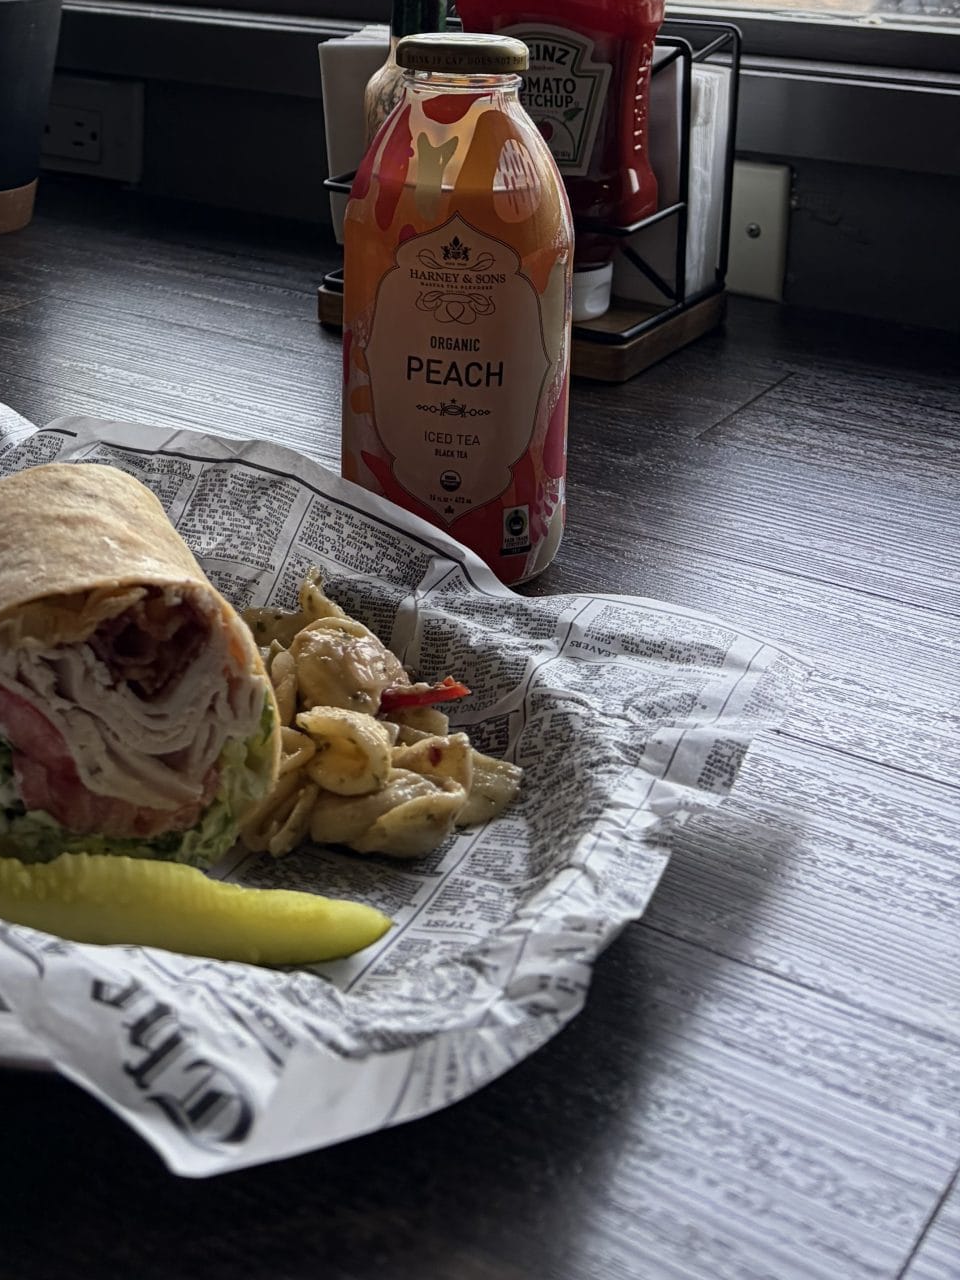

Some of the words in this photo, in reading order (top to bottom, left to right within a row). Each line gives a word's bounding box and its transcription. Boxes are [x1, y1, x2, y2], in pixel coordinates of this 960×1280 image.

[445, 55, 462, 66] CAP
[528, 45, 569, 65] EINZ
[520, 78, 576, 94] OMATO
[520, 93, 573, 108] ETCHUP
[409, 268, 460, 284] HARNEY
[462, 274, 473, 284] &
[475, 273, 507, 285] SONS
[429, 335, 481, 352] ORGANIC
[406, 355, 504, 388] PEACH
[424, 431, 452, 445] ICED
[456, 434, 481, 446] TEA
[434, 448, 455, 458] BLACK
[456, 449, 468, 459] TEA
[332, 519, 344, 529] the
[297, 534, 329, 555] COUPLE
[299, 529, 325, 546] WORK
[334, 533, 363, 551] RURAL
[345, 532, 374, 551] Married
[329, 544, 381, 574] INTERESTING
[333, 552, 372, 575] MARRIED
[374, 554, 384, 563] IN
[568, 638, 618, 659] LEAVERS
